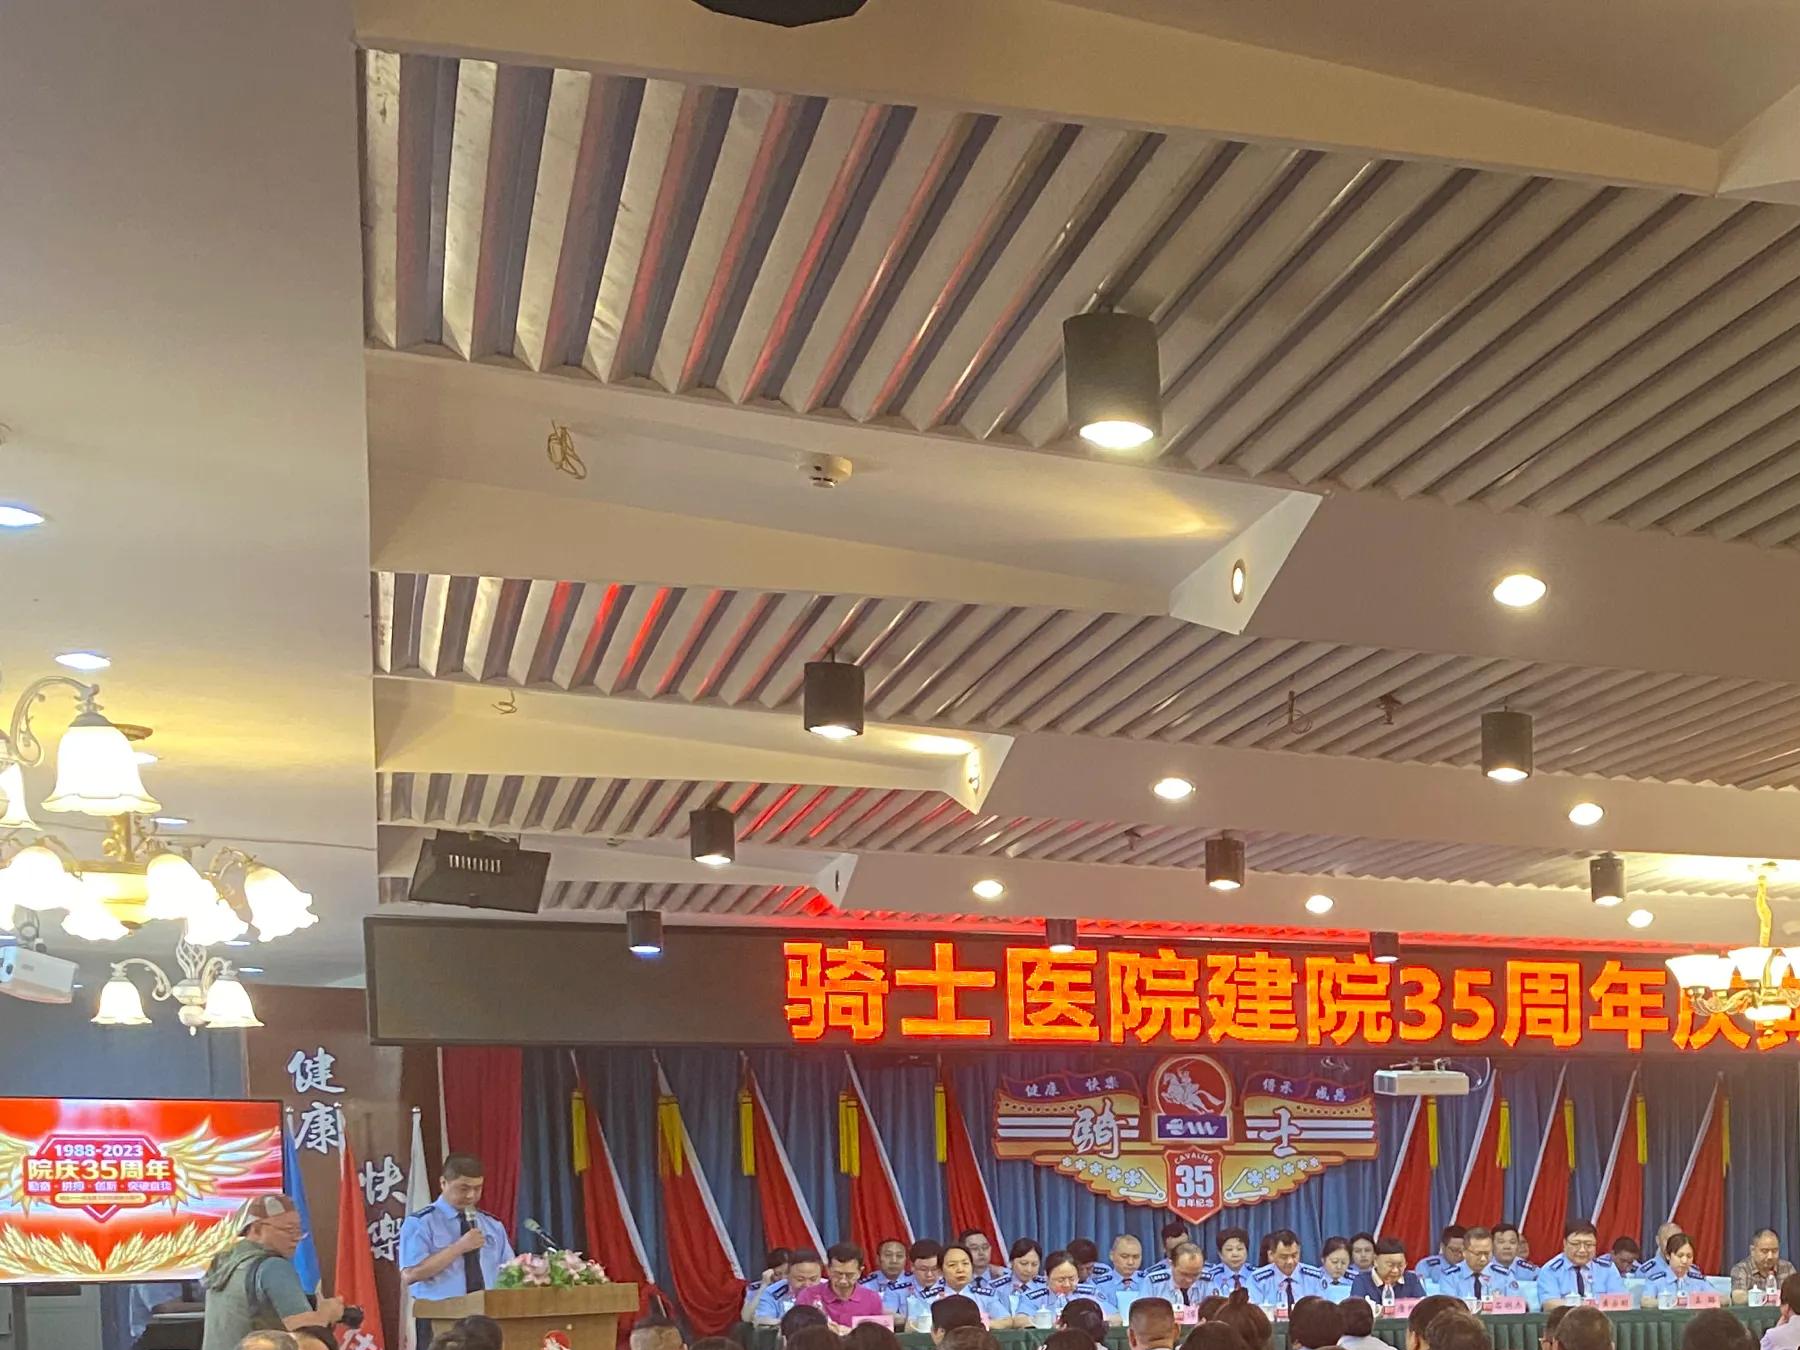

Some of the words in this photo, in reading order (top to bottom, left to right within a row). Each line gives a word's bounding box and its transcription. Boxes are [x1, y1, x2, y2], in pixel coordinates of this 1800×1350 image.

[287, 1046, 347, 1154] 健康
[53, 1143, 144, 1158] 1988-2023
[27, 1158, 171, 1182] 院庆35周年
[1175, 1164, 1215, 1198] 35
